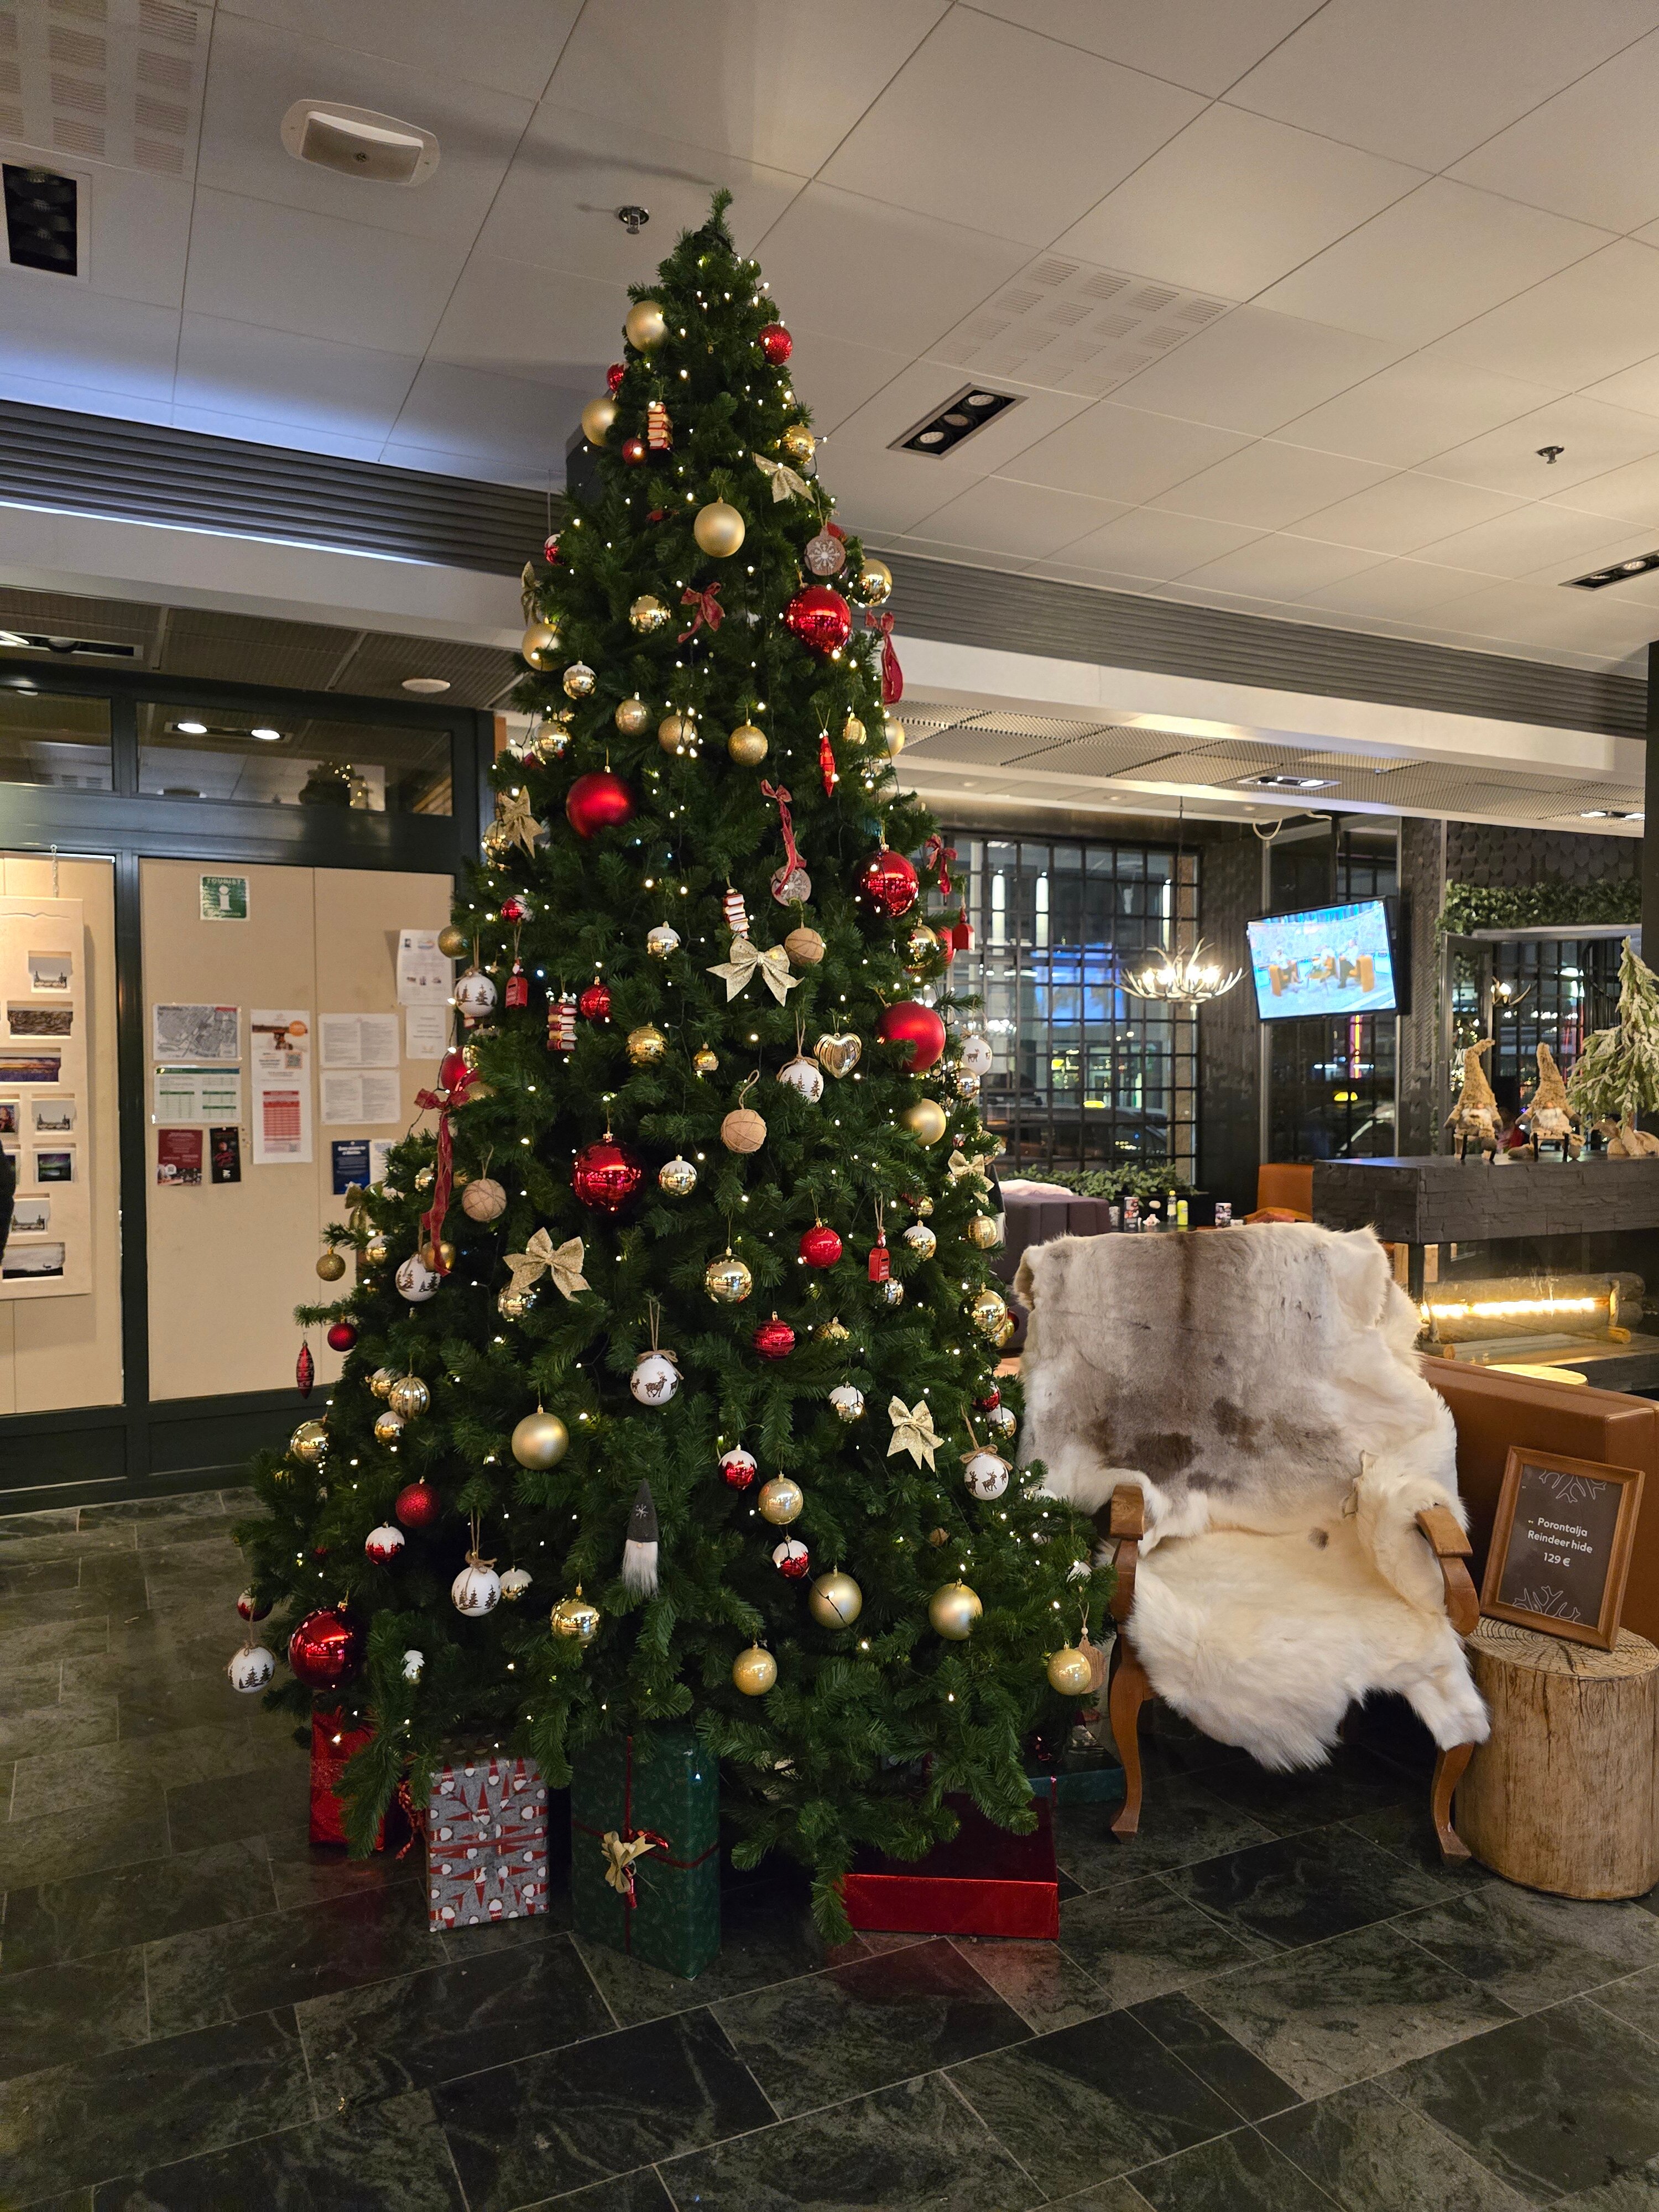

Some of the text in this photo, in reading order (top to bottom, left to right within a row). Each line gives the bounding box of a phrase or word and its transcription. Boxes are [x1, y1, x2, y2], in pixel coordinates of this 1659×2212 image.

[1537, 1517, 1588, 1537] Porontalja
[1528, 1530, 1593, 1553] Reindeer hide
[1544, 1552, 1571, 1567] 129 €
